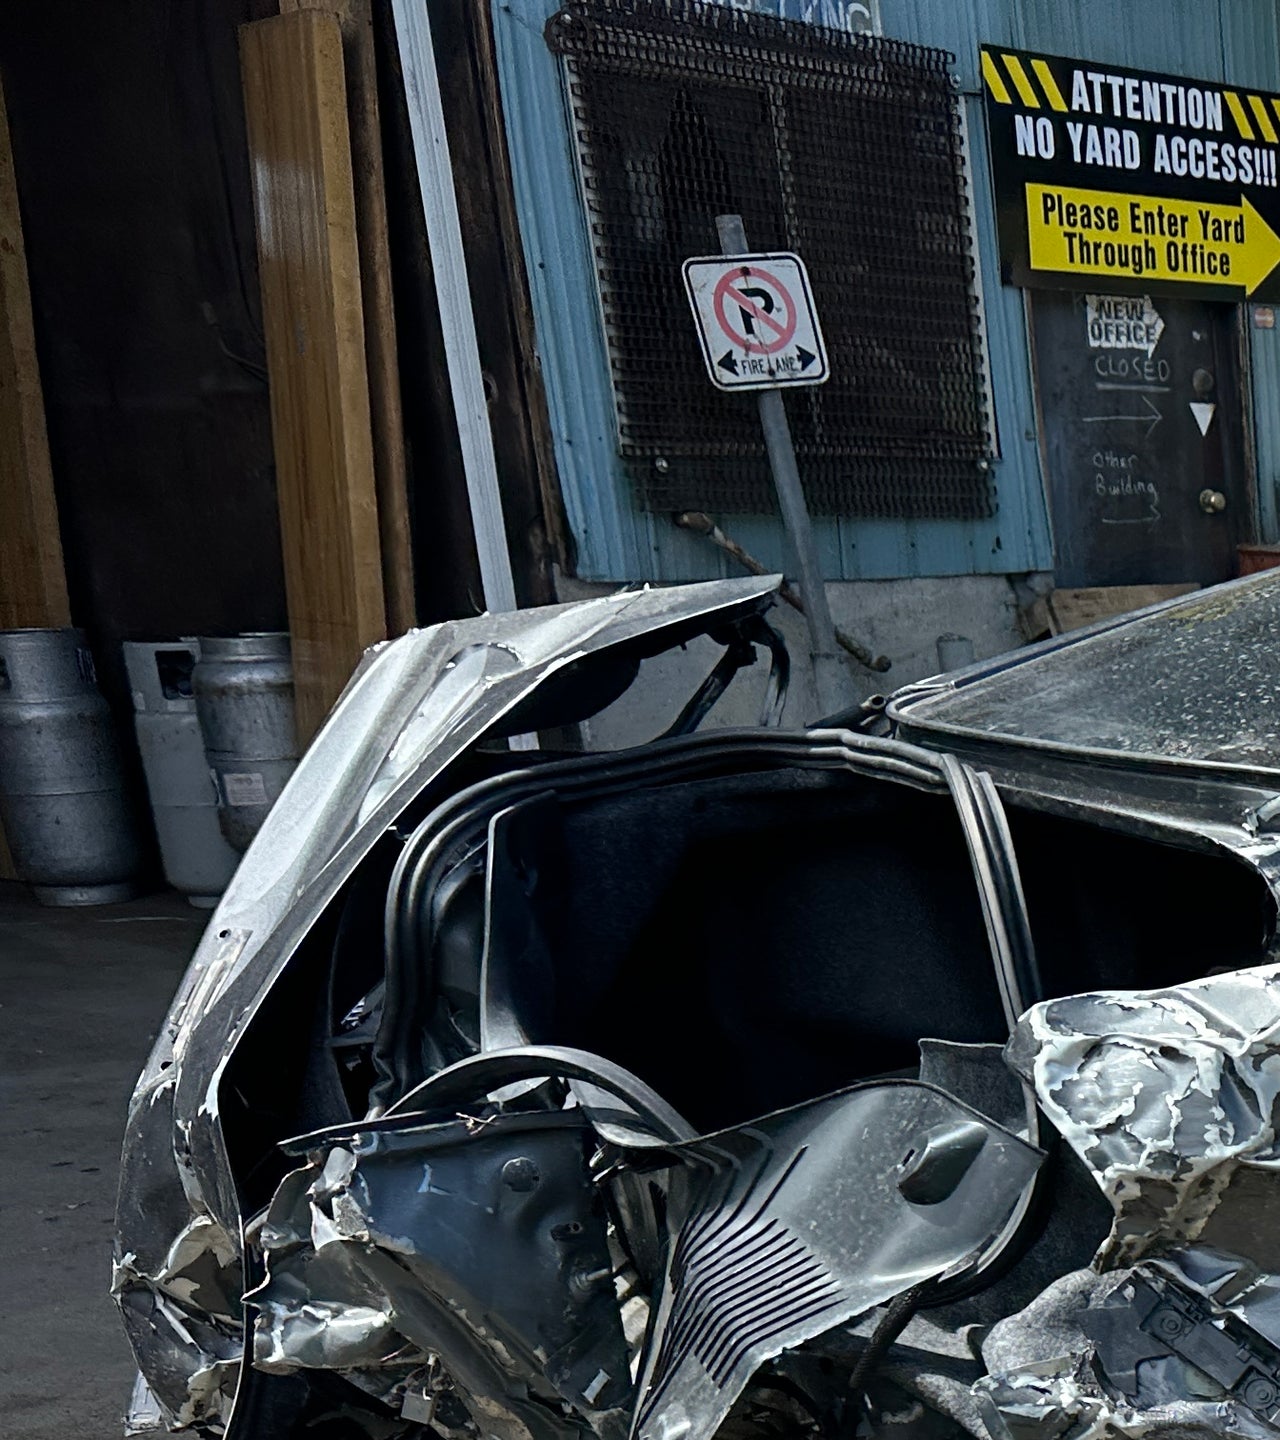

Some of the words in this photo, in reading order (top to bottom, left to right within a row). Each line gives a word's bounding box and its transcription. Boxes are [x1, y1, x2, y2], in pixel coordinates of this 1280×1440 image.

[1071, 70, 1223, 131] ATTENTION
[1014, 114, 1055, 160] NO
[1066, 122, 1140, 170] YARD
[1154, 140, 1278, 188] ACCESS!!!
[1042, 193, 1119, 231] Please
[1130, 203, 1189, 239] Enter
[1198, 210, 1245, 244] Yard
[1063, 231, 1157, 275] Through
[1166, 241, 1231, 276] Office
[1095, 299, 1144, 320] NEW
[1090, 318, 1156, 343] OFFICE
[741, 359, 766, 375] FIRE
[1095, 355, 1170, 381] CLOSED
